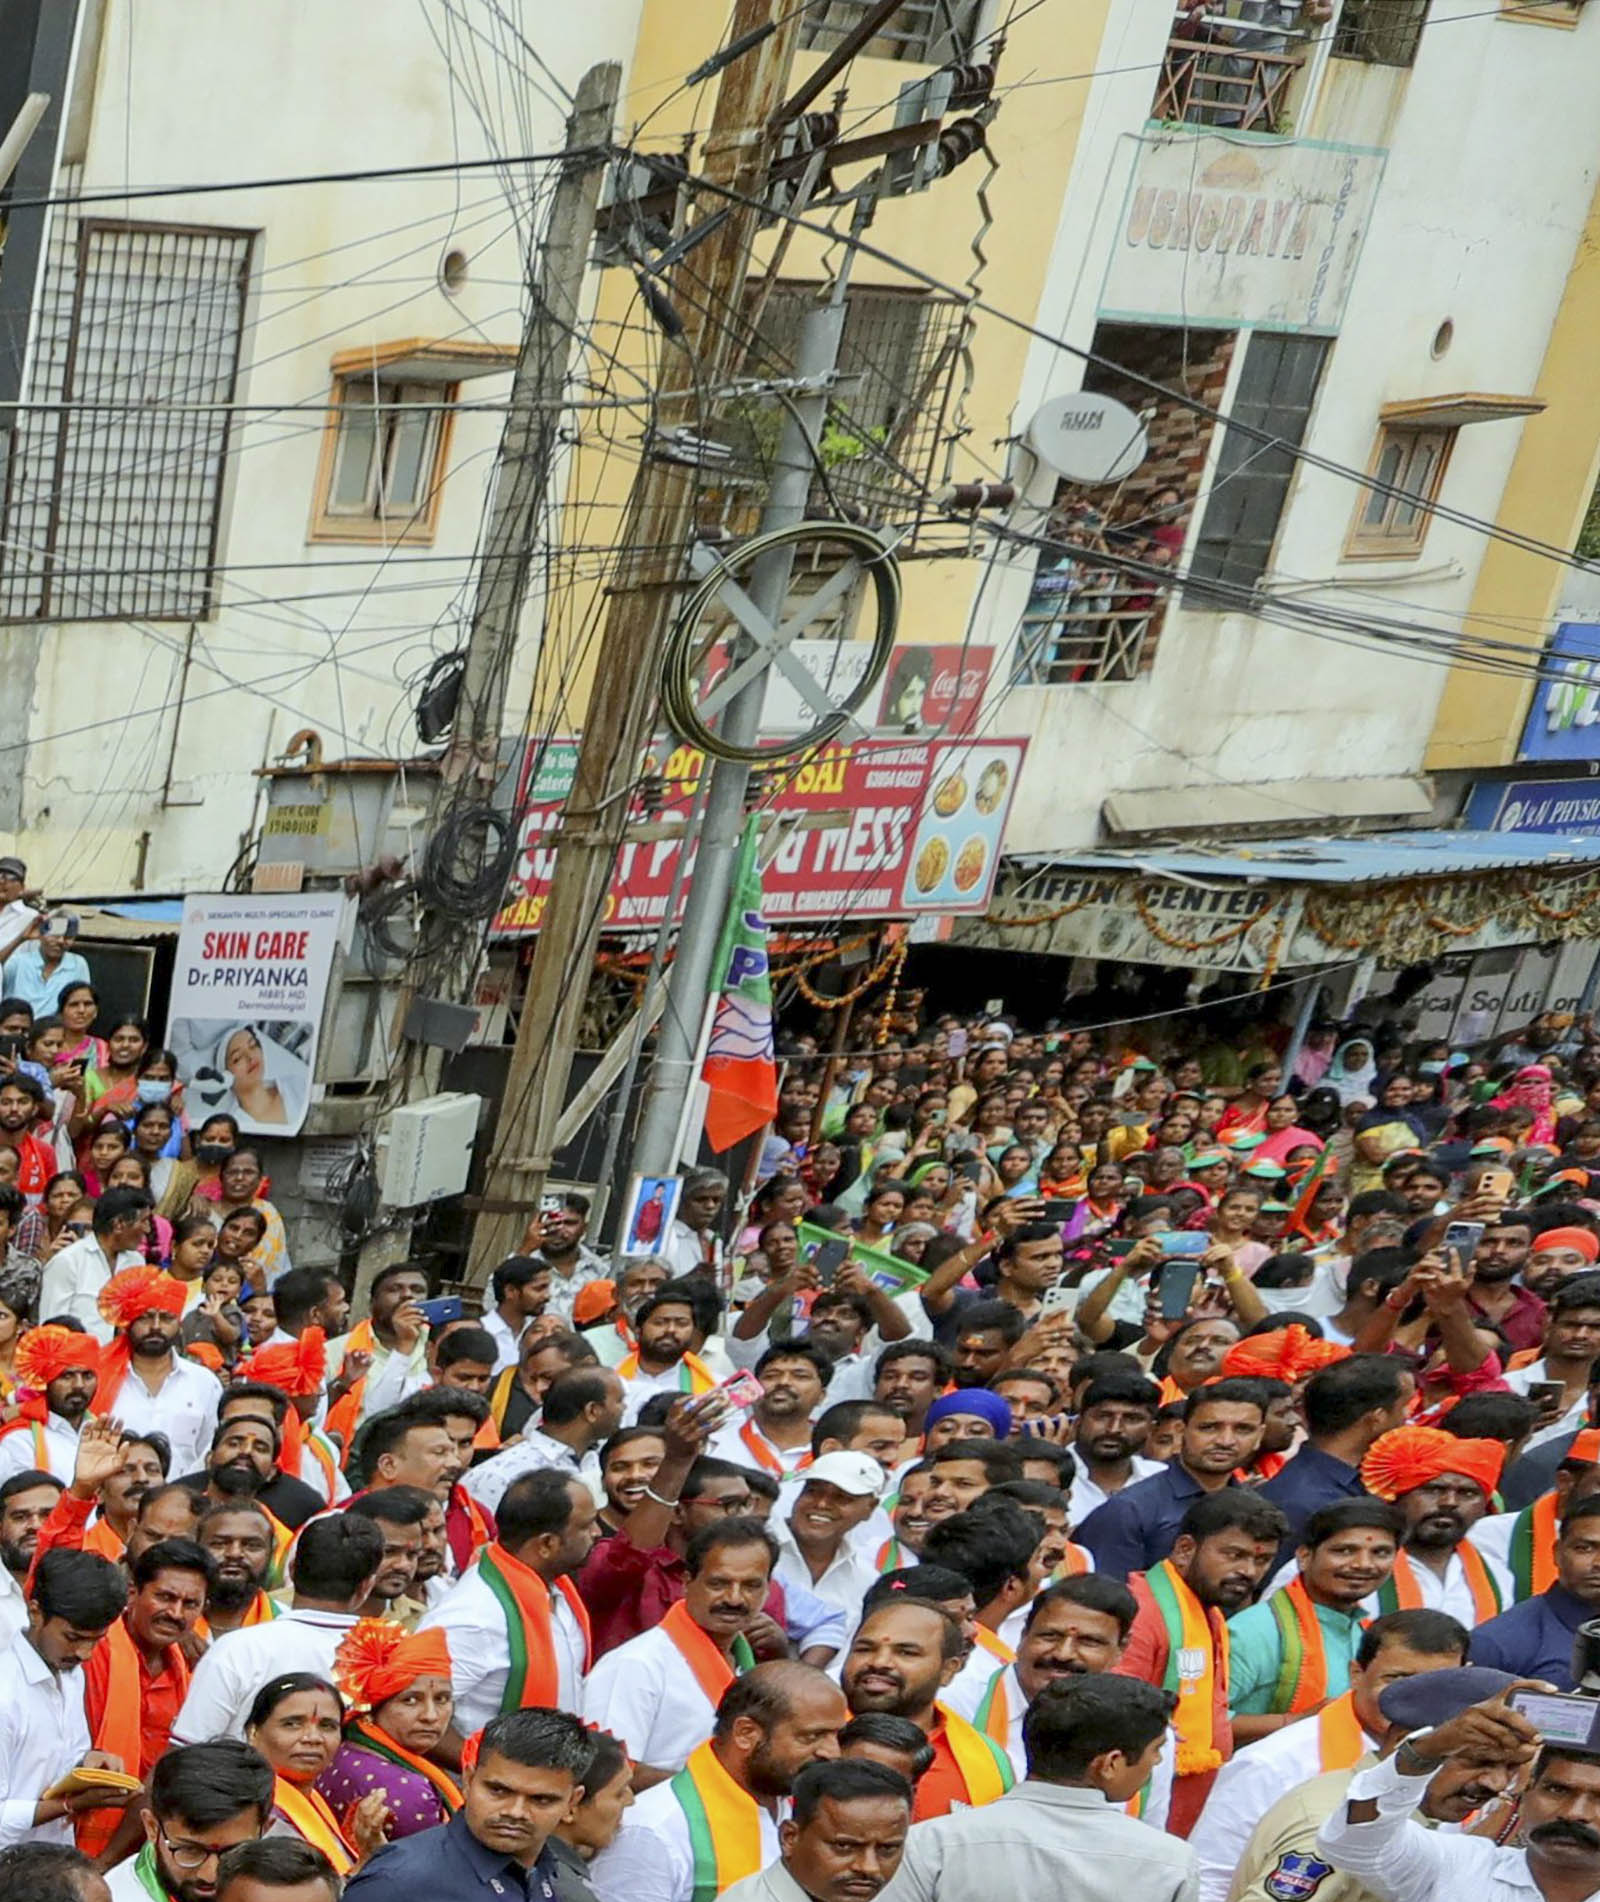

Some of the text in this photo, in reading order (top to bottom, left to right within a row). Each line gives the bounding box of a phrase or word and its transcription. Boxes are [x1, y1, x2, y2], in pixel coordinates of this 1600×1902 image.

[202, 930, 311, 961] SKIN CARE
[187, 967, 309, 988] Dr.PRIYANKA
